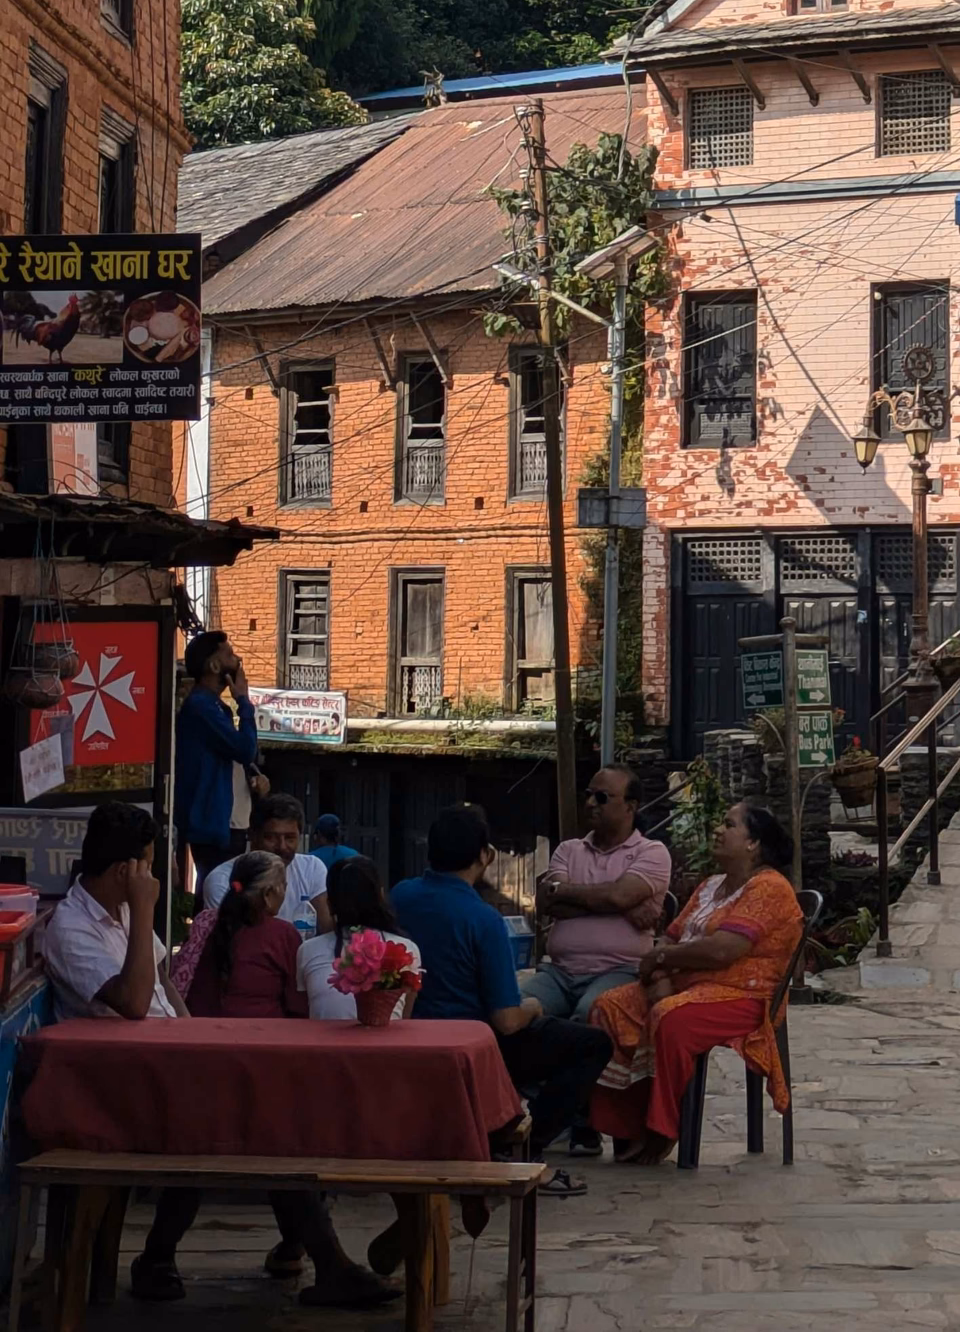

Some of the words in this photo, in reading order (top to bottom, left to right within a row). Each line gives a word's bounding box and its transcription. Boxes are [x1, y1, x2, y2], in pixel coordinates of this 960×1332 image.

[18, 241, 84, 283] रैथाने
[90, 250, 151, 282] खाना
[157, 250, 193, 281] घर
[46, 371, 69, 383] खाना
[109, 368, 139, 382] लोकल
[69, 385, 99, 399] लोकल
[169, 384, 195, 397] तयारी
[87, 405, 110, 416] खाना
[112, 401, 129, 415] पनि
[798, 733, 813, 750] Bus
[813, 733, 834, 750] Park
